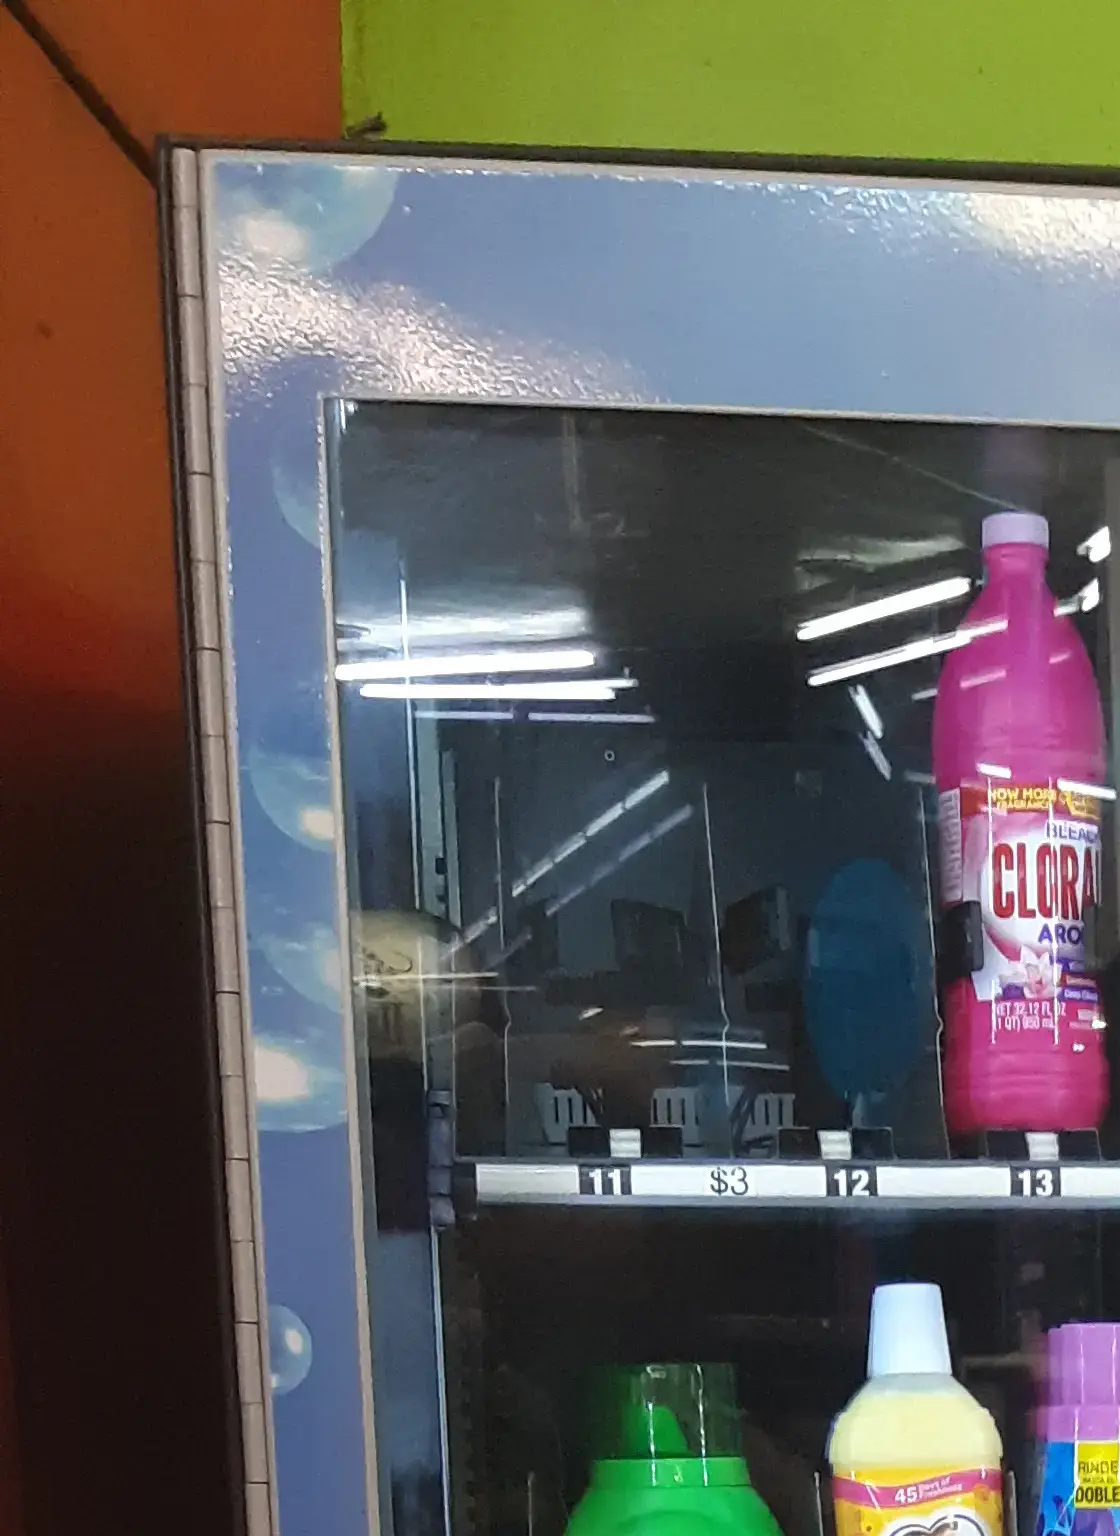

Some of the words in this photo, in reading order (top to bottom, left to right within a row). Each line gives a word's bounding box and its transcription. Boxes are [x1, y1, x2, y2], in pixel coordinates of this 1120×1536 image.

[588, 1170, 624, 1195] 11
[709, 1166, 750, 1197] $3
[832, 1171, 871, 1197] 12
[1018, 1170, 1056, 1197] 13
[895, 1486, 918, 1505] 45
